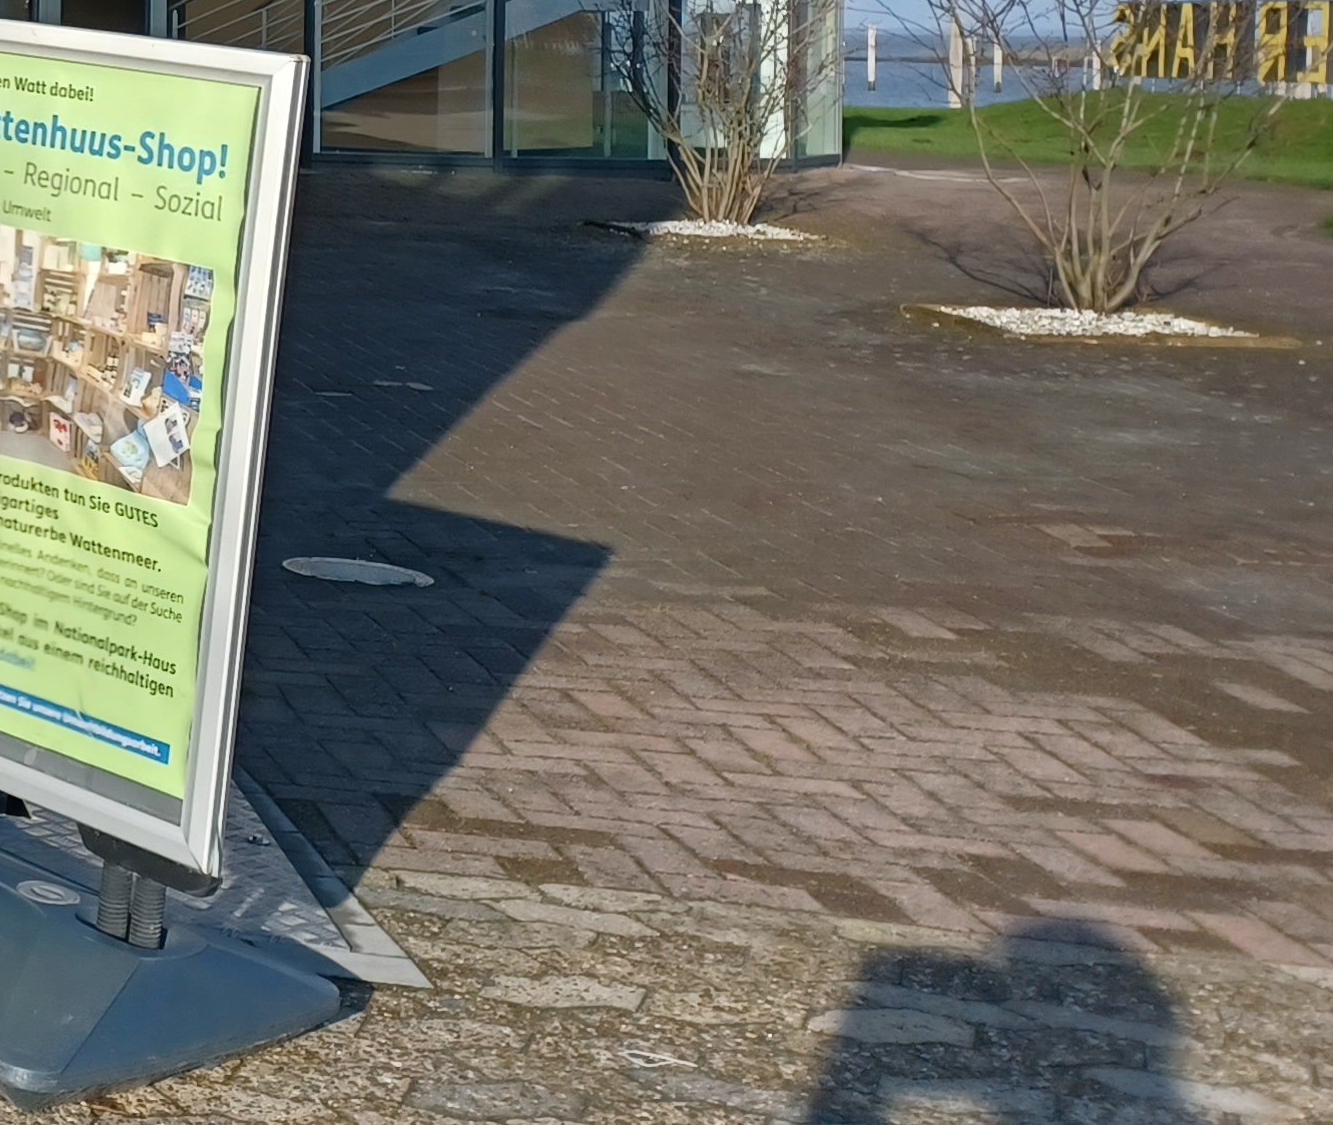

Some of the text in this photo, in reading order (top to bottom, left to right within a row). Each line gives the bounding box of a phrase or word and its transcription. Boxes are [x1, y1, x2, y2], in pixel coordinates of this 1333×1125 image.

[14, 76, 46, 94] Watt
[49, 81, 93, 101] dabei!
[24, 161, 118, 200] Regional
[154, 185, 222, 221] Sozial
[2, 200, 51, 222] Umwelt
[63, 488, 85, 506] tun
[89, 495, 110, 513] Sie
[114, 501, 158, 527] GUTES
[69, 532, 160, 571] Wattenmeer.
[141, 584, 183, 603] unseren
[150, 601, 182, 623] Suche
[55, 621, 175, 674] Nationalpark-Haus
[43, 643, 83, 664] einem
[88, 658, 173, 697] reichhaltigen
